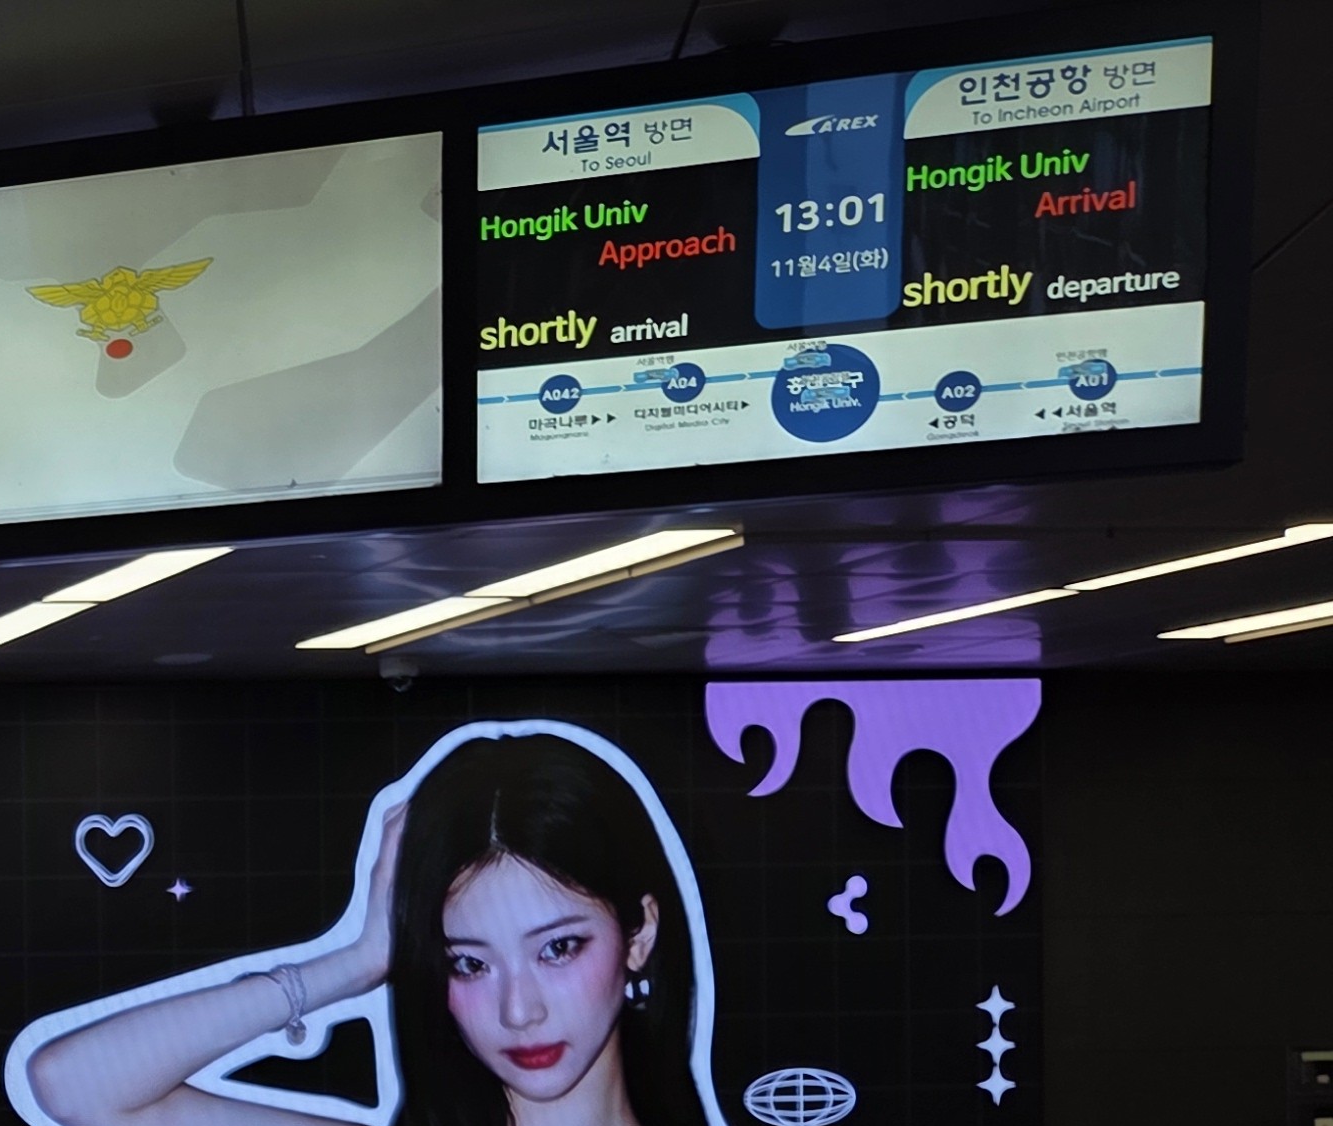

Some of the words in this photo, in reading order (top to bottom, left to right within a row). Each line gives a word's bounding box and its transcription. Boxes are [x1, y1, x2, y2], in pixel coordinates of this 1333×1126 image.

[959, 64, 1092, 106] 인천공항
[1103, 61, 1156, 89] 방면
[972, 111, 993, 125] To
[997, 103, 1073, 123] Incheon
[1079, 93, 1140, 114] Airport
[541, 121, 631, 155] 서울역
[644, 117, 692, 145] 방면
[581, 159, 600, 173] To
[605, 151, 652, 170] Seoul
[906, 155, 1014, 192] Hongik
[1020, 149, 1090, 180] Univ
[775, 193, 885, 233] 13:01
[1035, 181, 1137, 218] Arrival
[480, 205, 578, 241] Hongik
[584, 200, 648, 229] Univ
[598, 225, 736, 270] Approach
[902, 265, 1033, 308] shortly
[1047, 270, 1181, 302] departure
[480, 310, 598, 350] shortly
[610, 312, 689, 344] arrival
[542, 387, 580, 402] A042
[667, 376, 698, 390] A04
[941, 386, 975, 400] A02
[1075, 374, 1109, 388] A01
[943, 414, 975, 429] 공덕
[1066, 402, 1116, 418] 서울역
